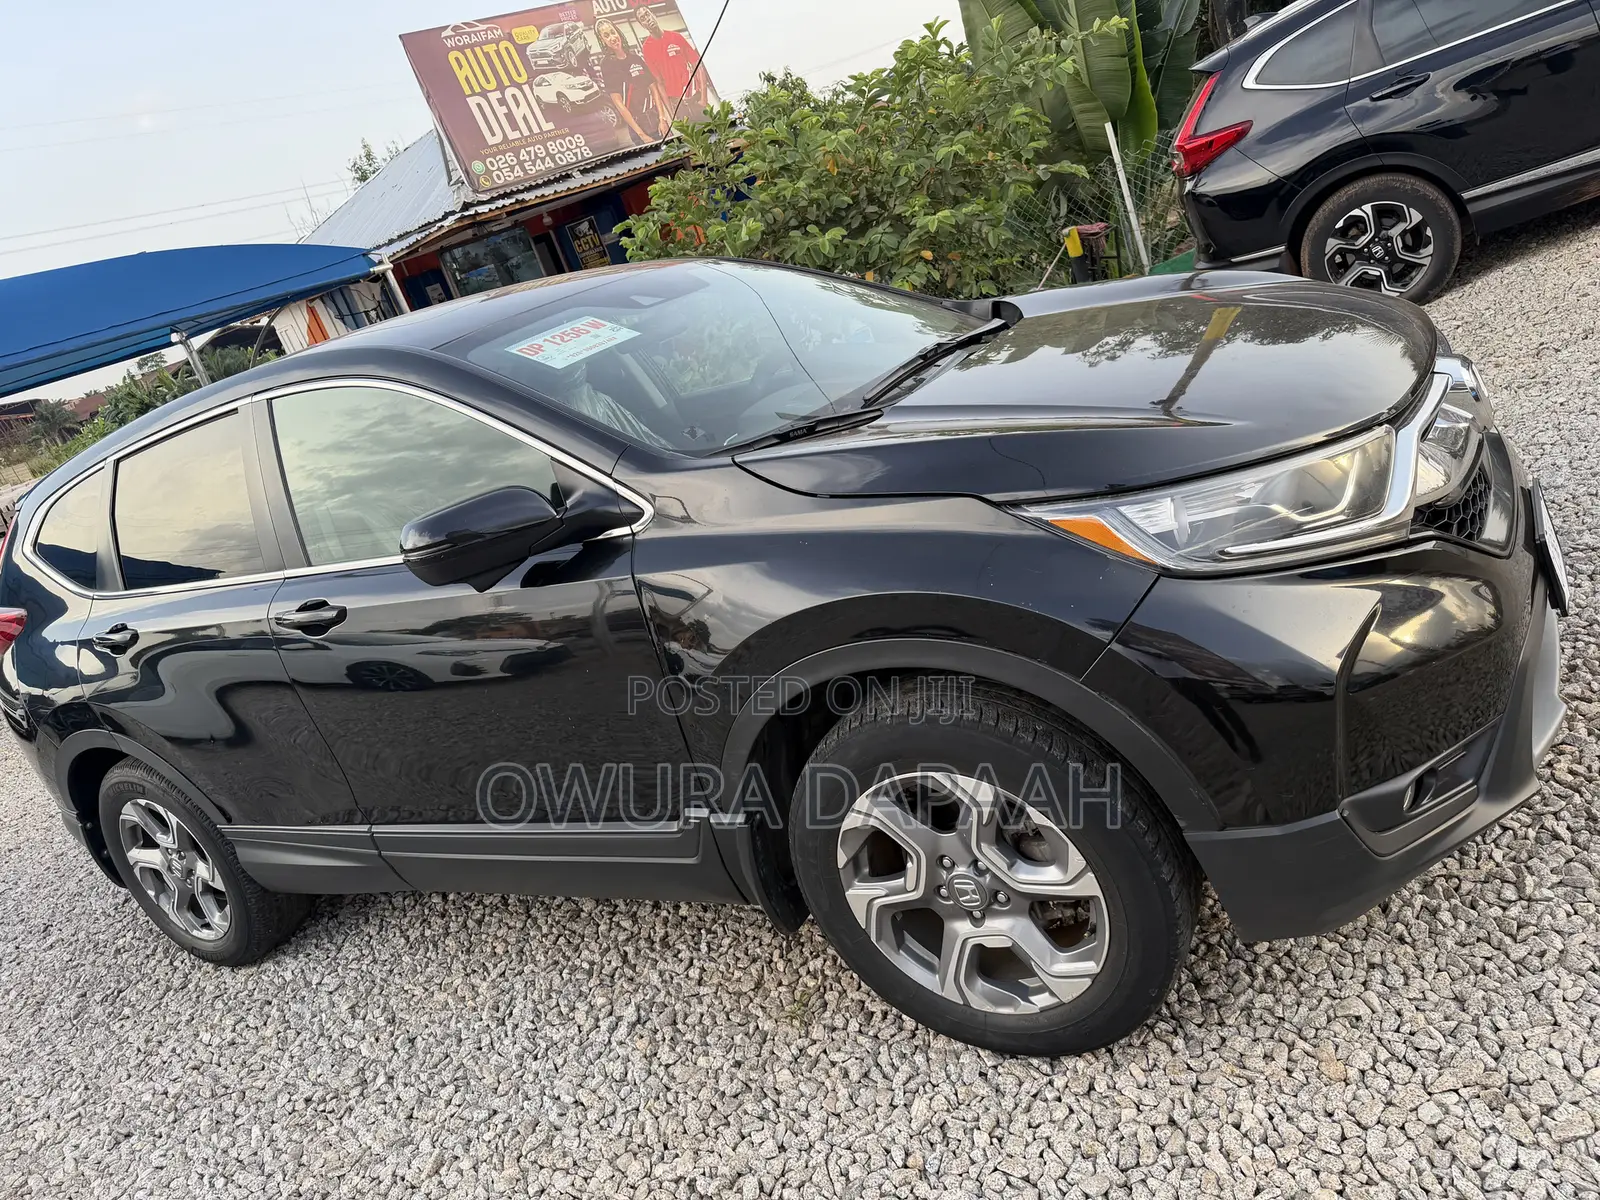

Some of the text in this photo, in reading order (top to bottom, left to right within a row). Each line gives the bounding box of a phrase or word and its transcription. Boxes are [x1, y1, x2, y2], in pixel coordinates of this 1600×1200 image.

[443, 28, 504, 48] WORAIFAM
[448, 40, 528, 95] AUTO
[465, 84, 555, 146] DEAL
[480, 128, 570, 155] YOUR RELIABLE AUTO PARTNER
[486, 134, 586, 171] 026 479 8009
[493, 146, 593, 184] 054 544 0878
[574, 233, 600, 253] CCTV
[516, 343, 545, 357] DP
[543, 327, 591, 346] 1256
[580, 319, 607, 330] W
